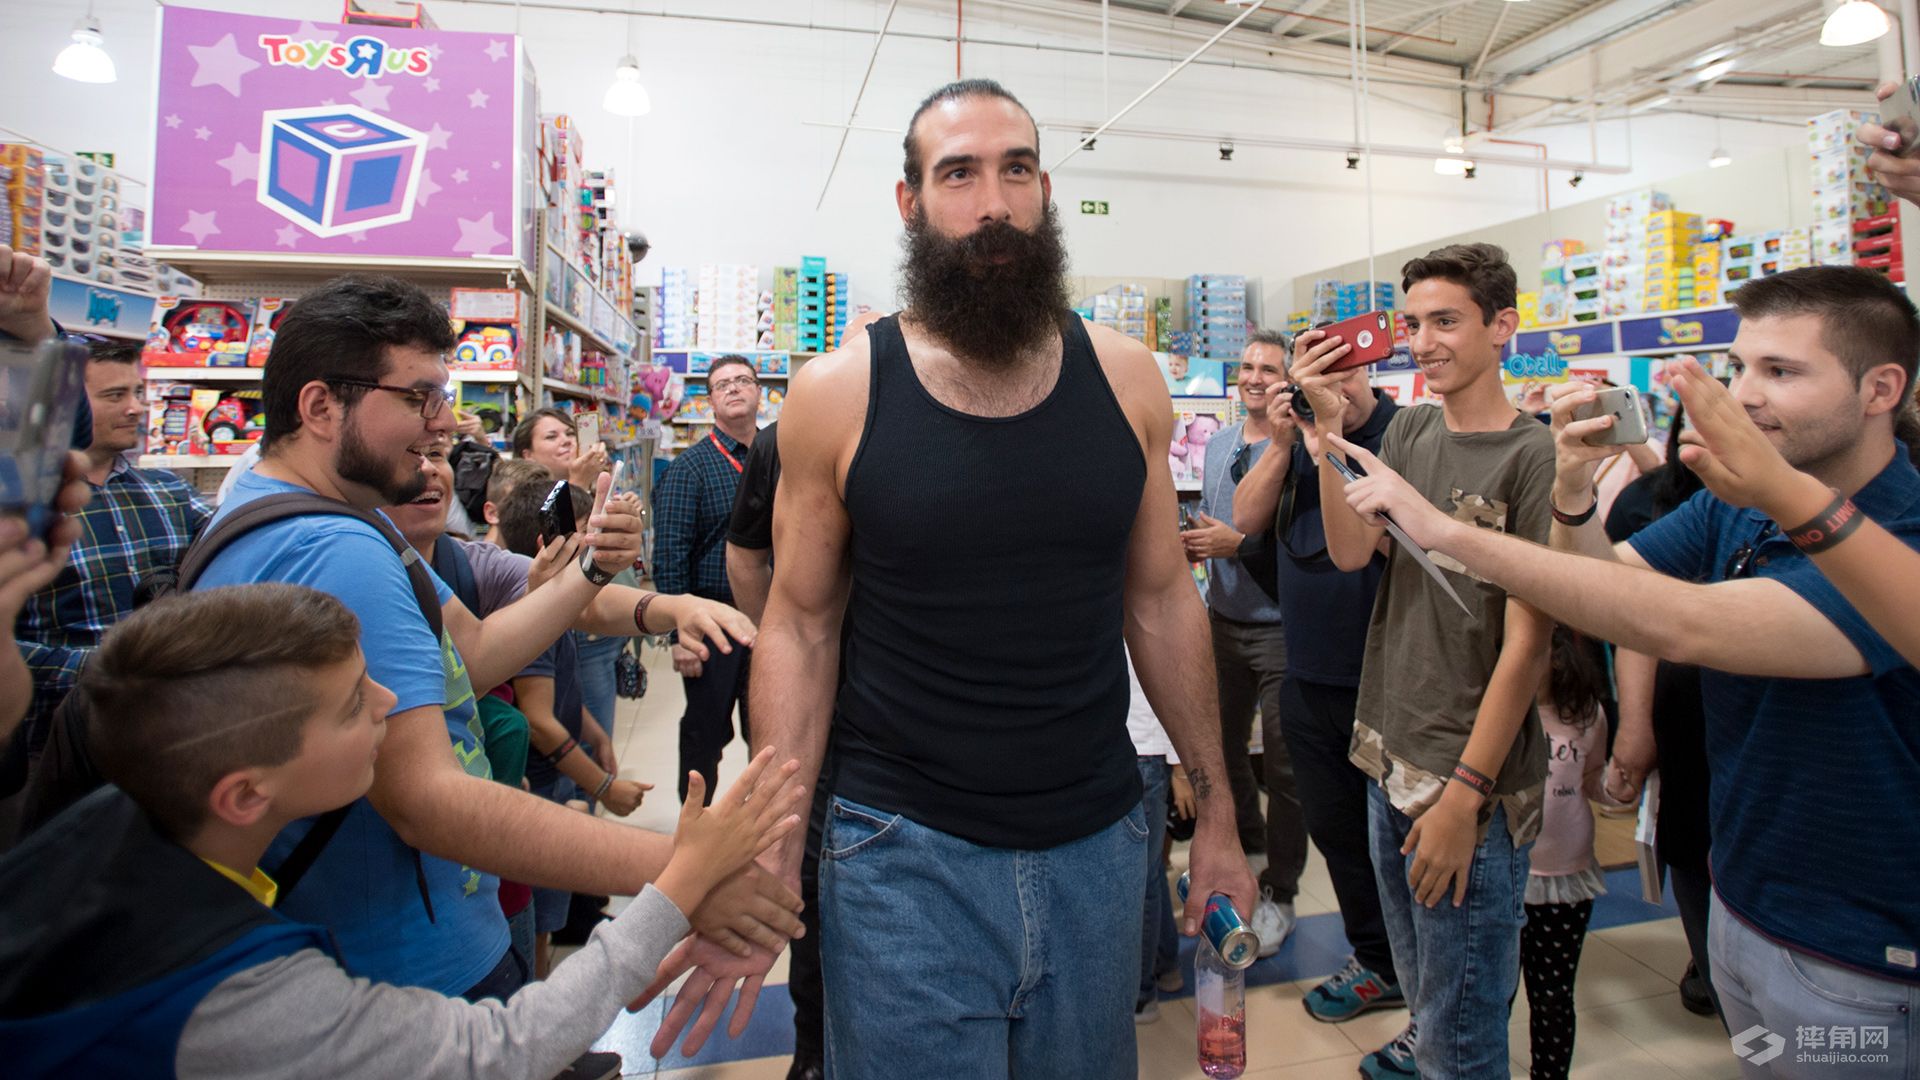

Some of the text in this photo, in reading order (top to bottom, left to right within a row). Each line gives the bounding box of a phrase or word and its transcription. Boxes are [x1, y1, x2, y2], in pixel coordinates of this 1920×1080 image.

[1825, 499, 1857, 535] DMIT
[1546, 731, 1578, 763] ter
[1353, 979, 1382, 1002] N
